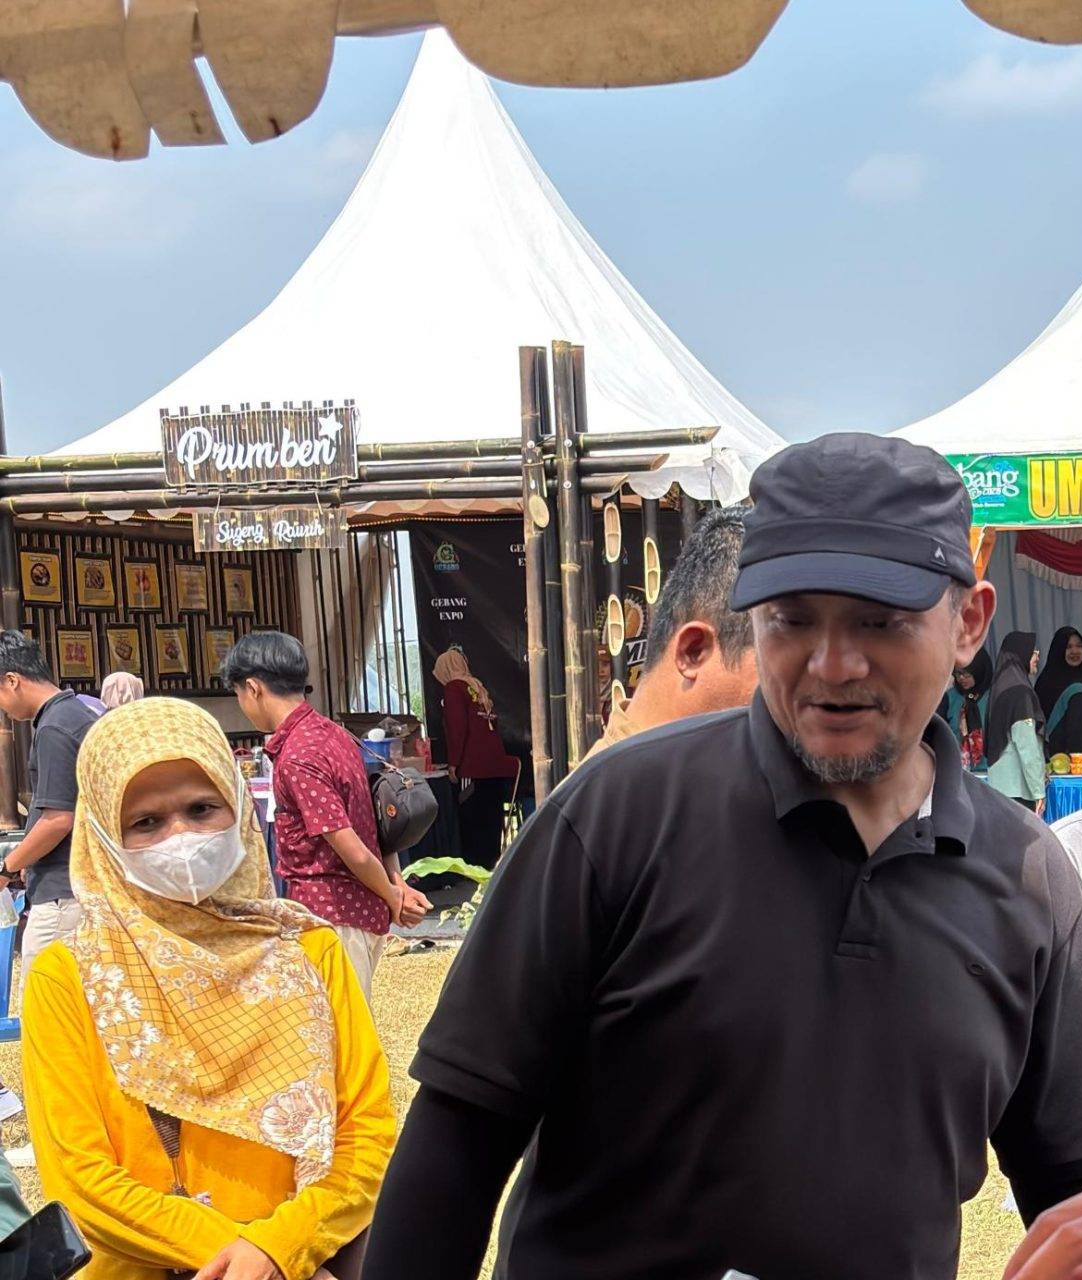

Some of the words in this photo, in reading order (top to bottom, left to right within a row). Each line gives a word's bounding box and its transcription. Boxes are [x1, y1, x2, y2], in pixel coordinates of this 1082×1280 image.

[957, 462, 1020, 497] bang
[216, 520, 264, 546] Sugeng
[431, 598, 467, 607] GEBANG
[440, 612, 464, 620] EXPO
